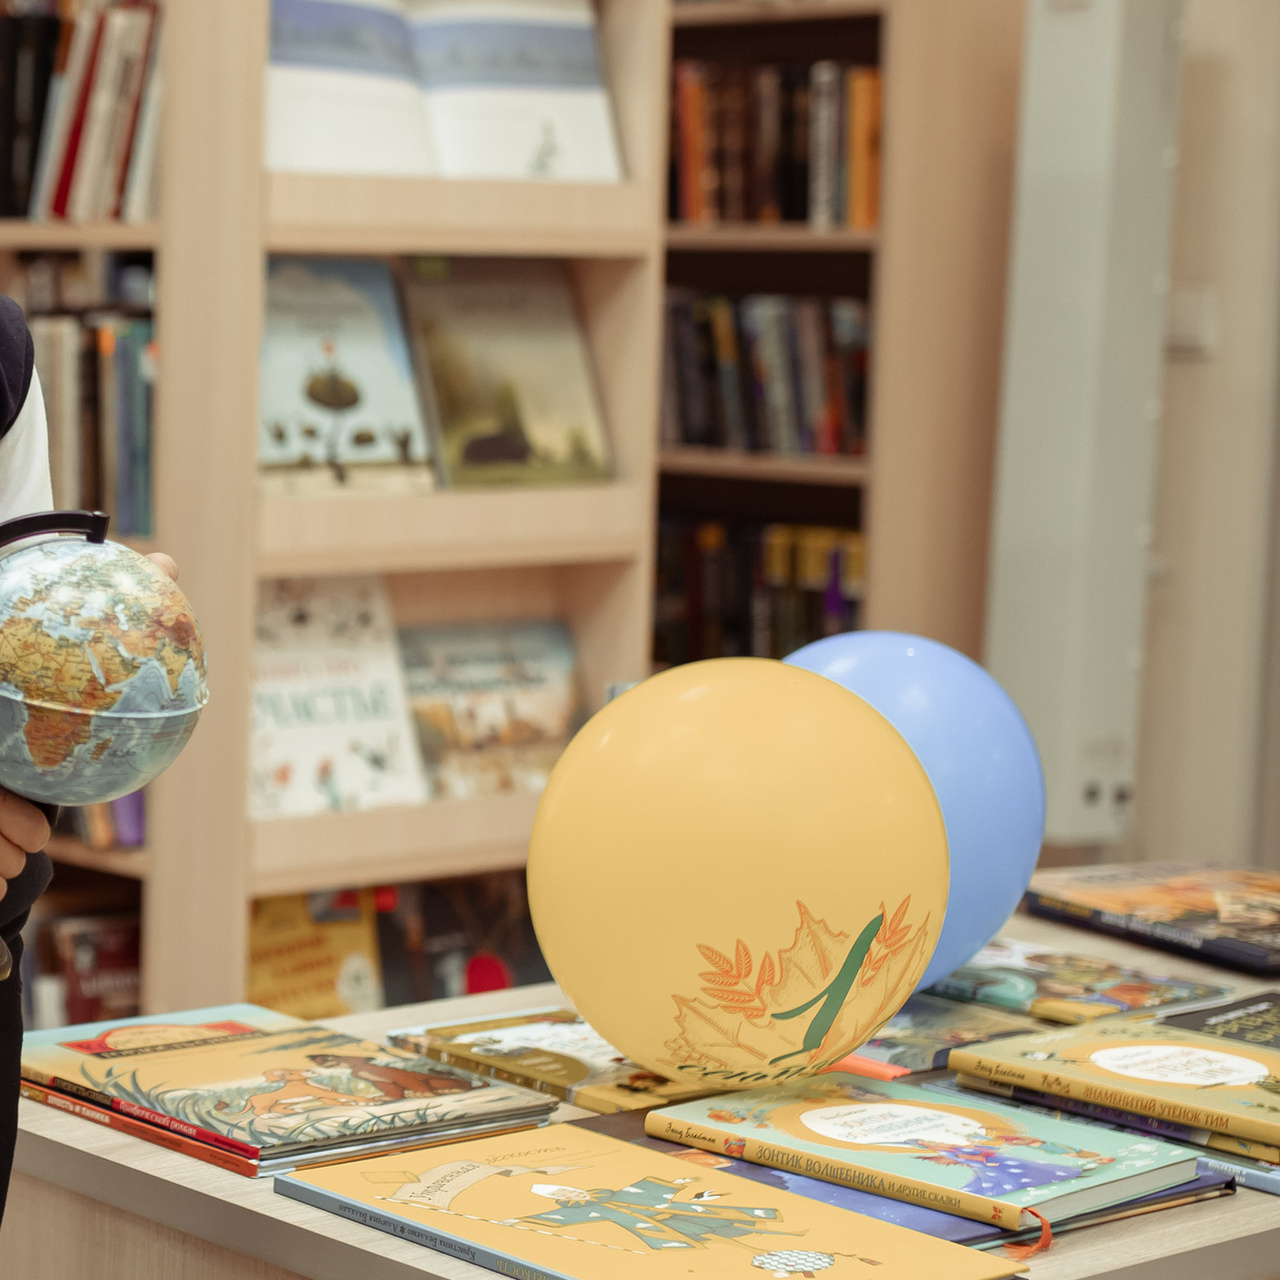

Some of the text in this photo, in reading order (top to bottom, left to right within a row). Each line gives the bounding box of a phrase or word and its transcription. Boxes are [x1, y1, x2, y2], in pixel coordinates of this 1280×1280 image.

[1083, 1084, 1157, 1113] ЗНАМЕНИТЫЙ
[1204, 1112, 1230, 1129] ТИМ
[408, 1163, 481, 1202] Утраченная
[756, 1145, 803, 1170] ЗОНТИК
[804, 1158, 886, 1192] ВОЛШЕБНИКА
[887, 1181, 895, 1192] И
[896, 1183, 928, 1200] ДРУГИЕ
[928, 1192, 961, 1209] СКАЗКИ
[439, 1239, 477, 1262] Кристина
